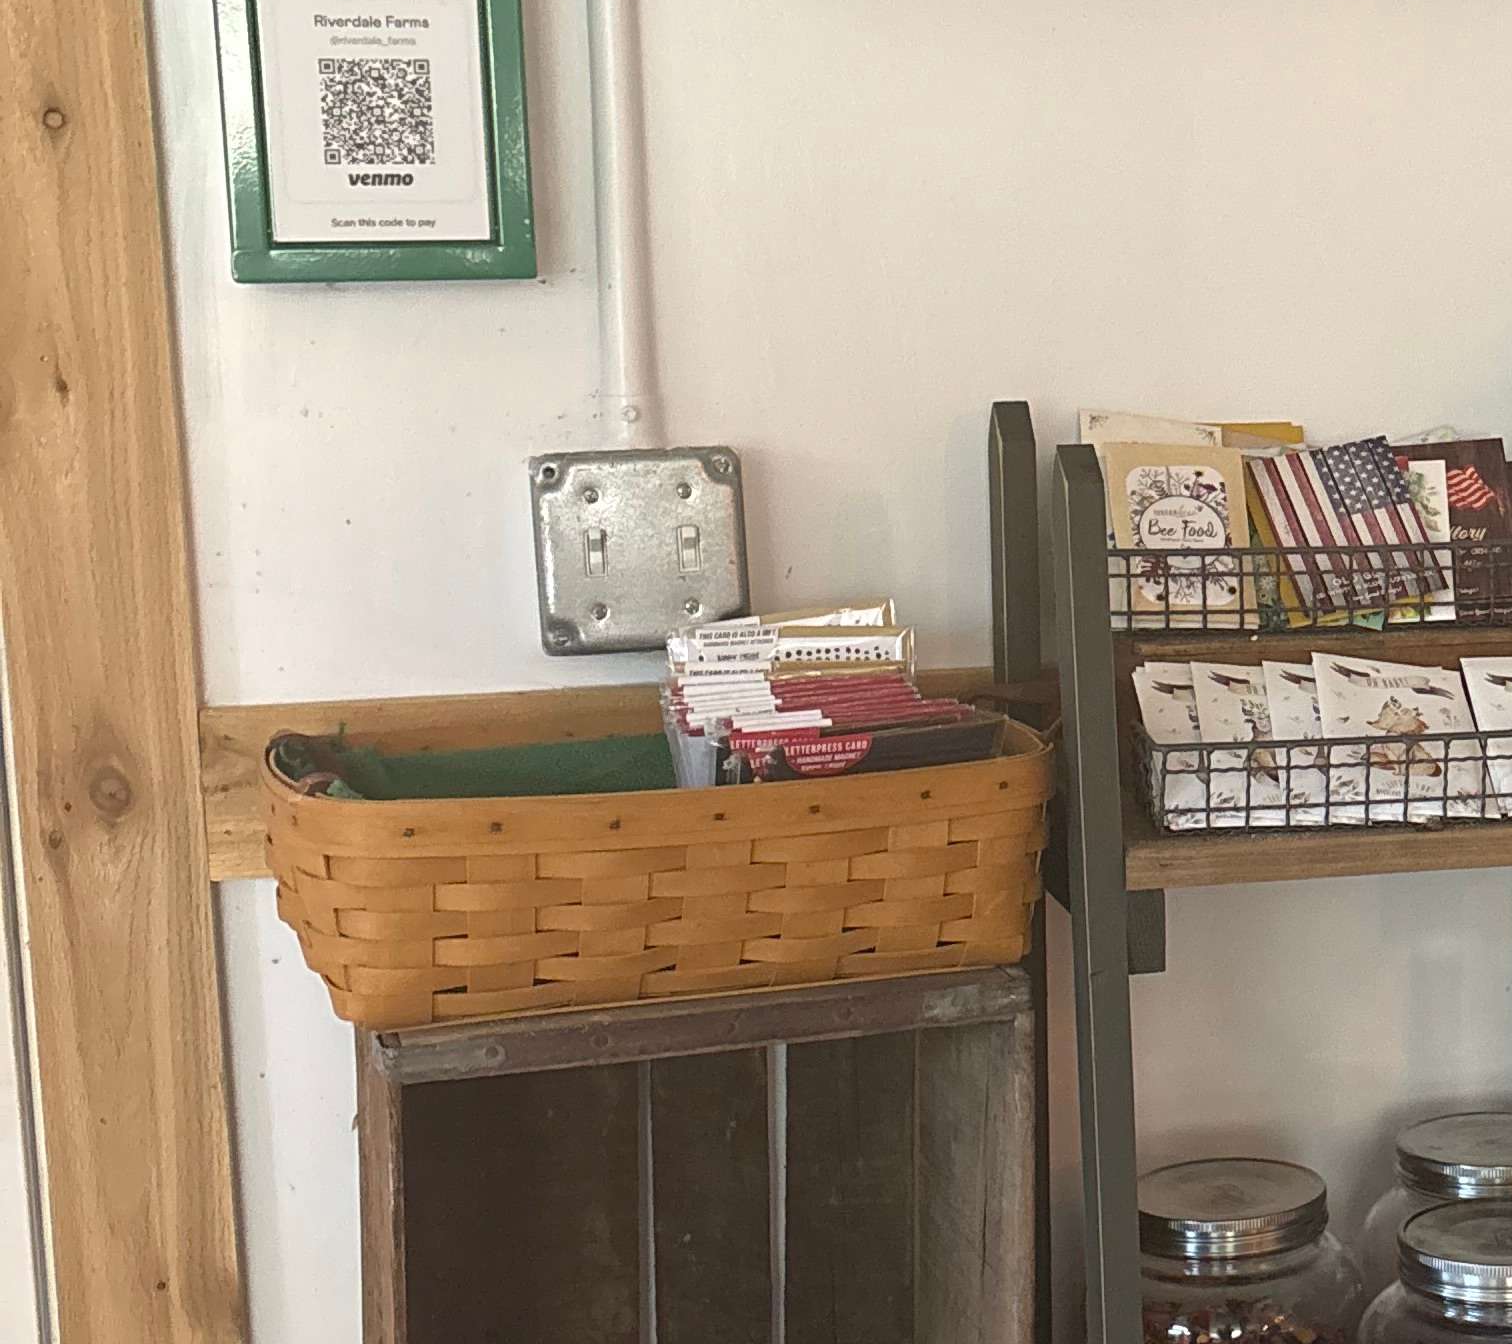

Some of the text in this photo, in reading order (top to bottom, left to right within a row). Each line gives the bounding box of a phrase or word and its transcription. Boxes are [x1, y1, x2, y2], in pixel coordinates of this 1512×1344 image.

[314, 14, 430, 29] Riverdale Farms
[348, 172, 414, 187] venmo
[331, 217, 436, 229] Scan this code to pay
[1148, 518, 1218, 539] Bee Food
[785, 740, 868, 756] LETTERPRESS CARD
